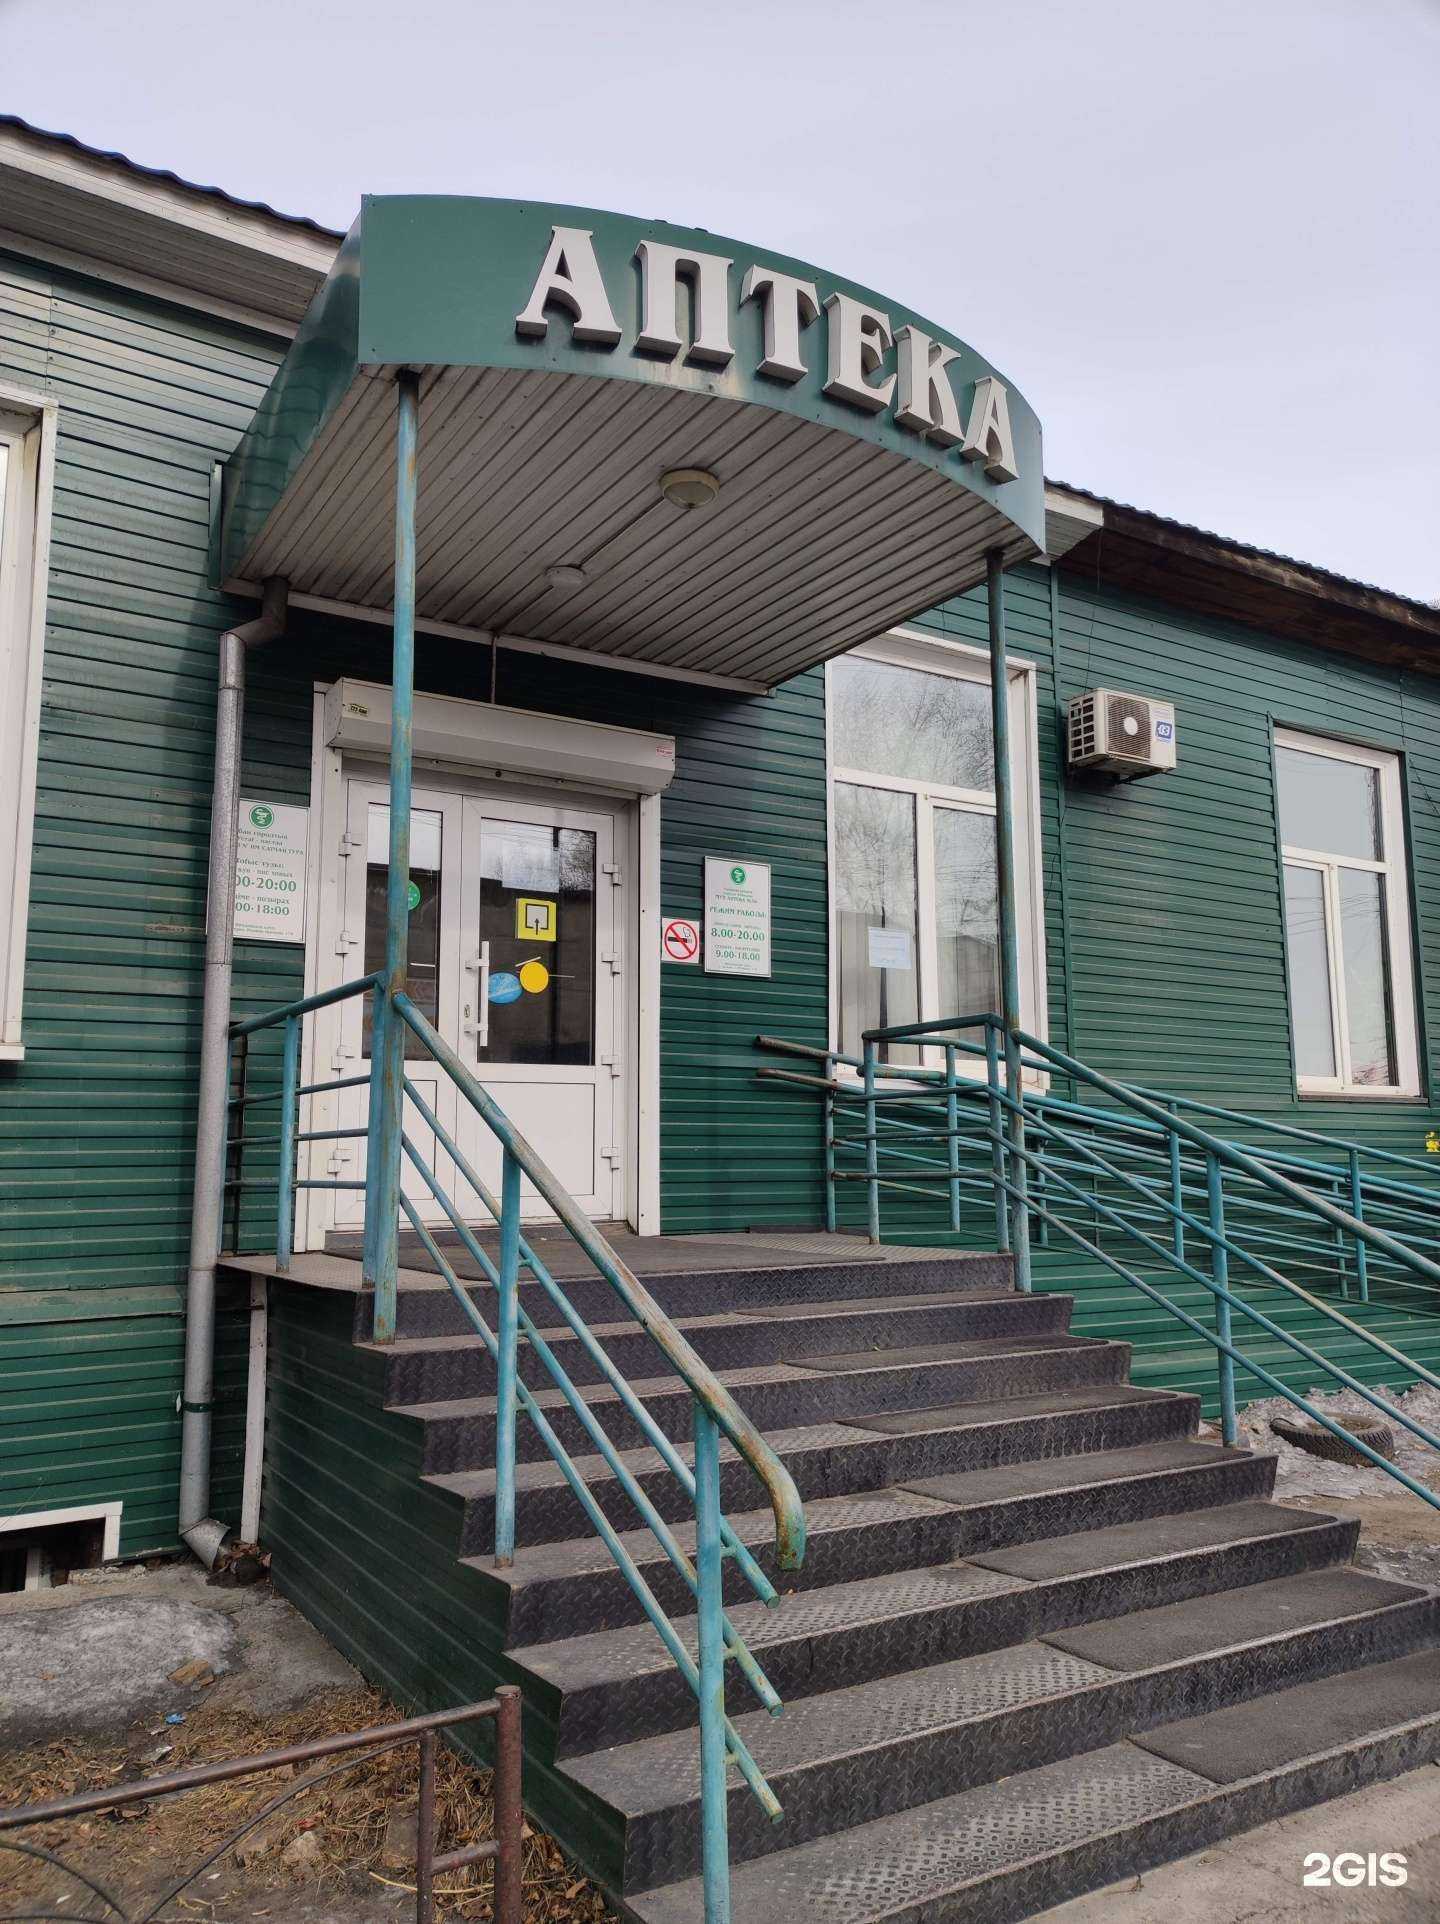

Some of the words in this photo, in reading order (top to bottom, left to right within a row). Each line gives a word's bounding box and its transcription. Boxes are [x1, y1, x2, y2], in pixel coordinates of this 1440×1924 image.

[515, 226, 1019, 483] АПТЕКА
[236, 875, 297, 892] 00-20:00
[235, 902, 290, 915] 00-18:00
[709, 905, 735, 915] РЕЖИМ
[711, 927, 765, 941] 8.00-20.00
[715, 950, 760, 961] 9.00-18.00
